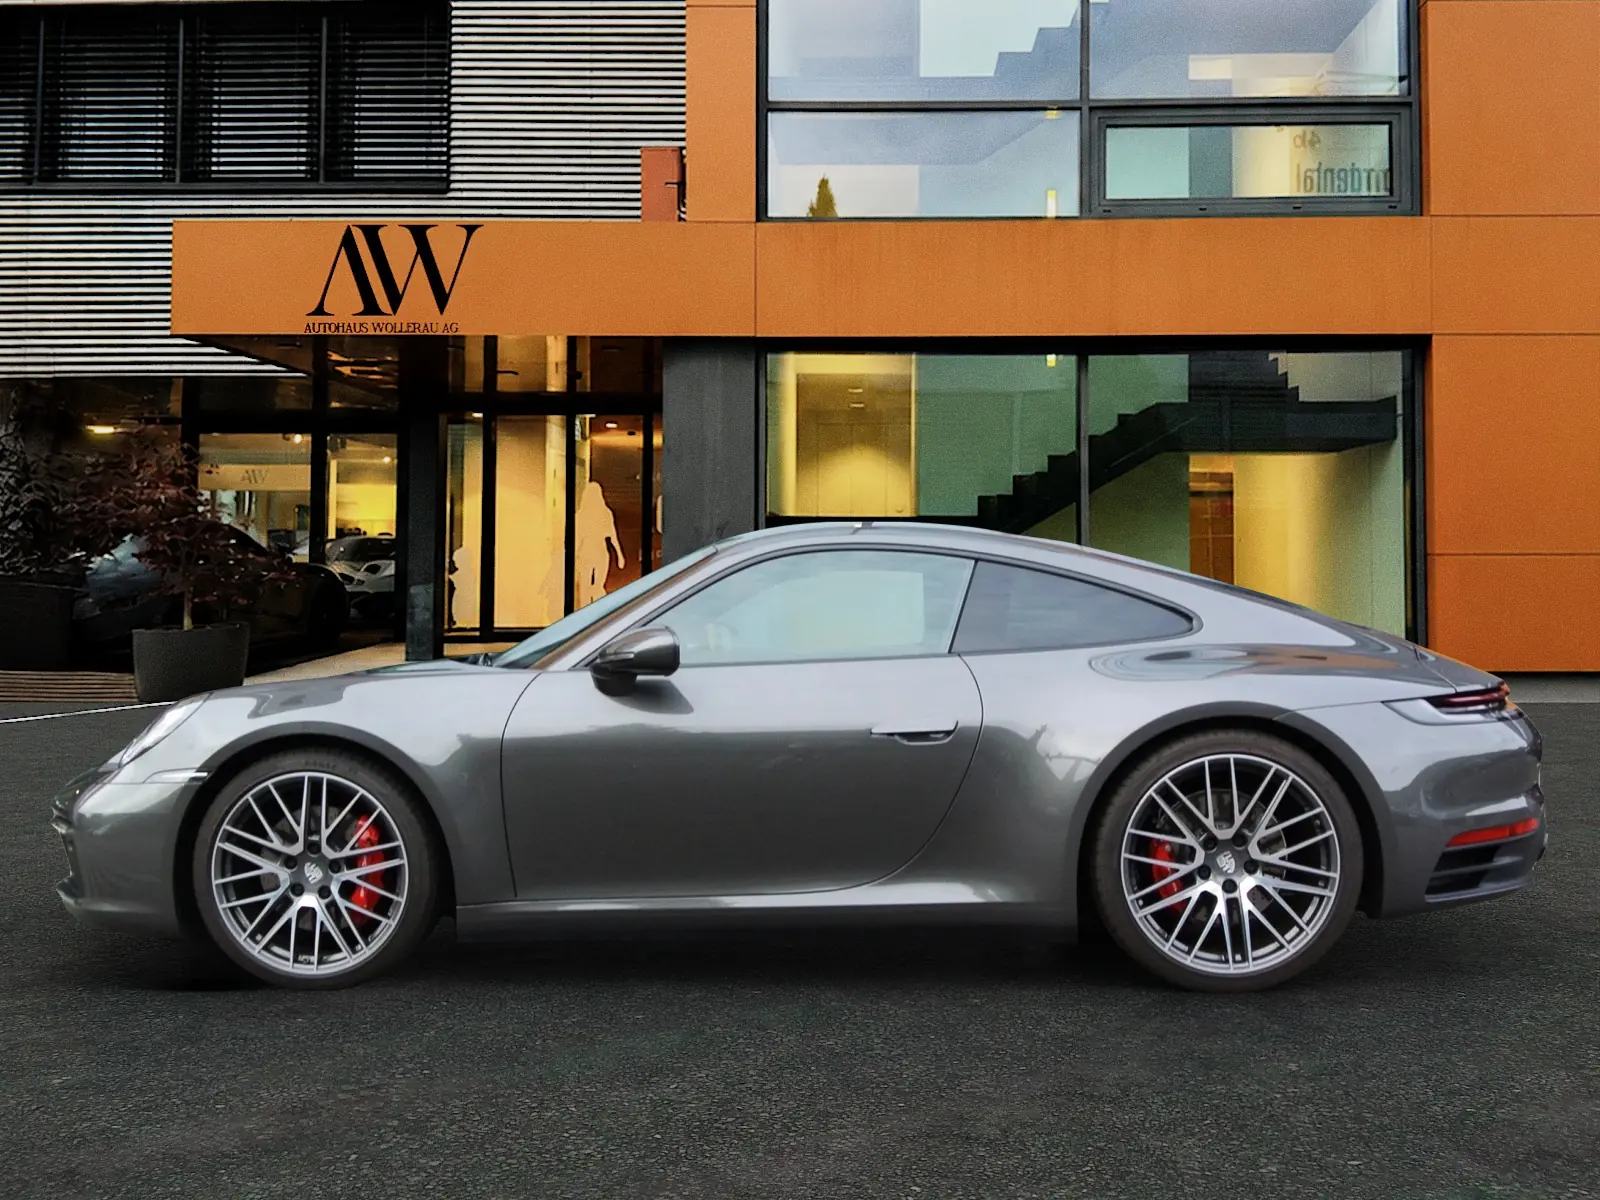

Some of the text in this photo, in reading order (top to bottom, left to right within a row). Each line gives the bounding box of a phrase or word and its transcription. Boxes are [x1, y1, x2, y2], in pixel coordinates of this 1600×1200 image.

[305, 224, 484, 316] AW
[304, 322, 459, 334] AUTOHAUS WOLLERAU AG
